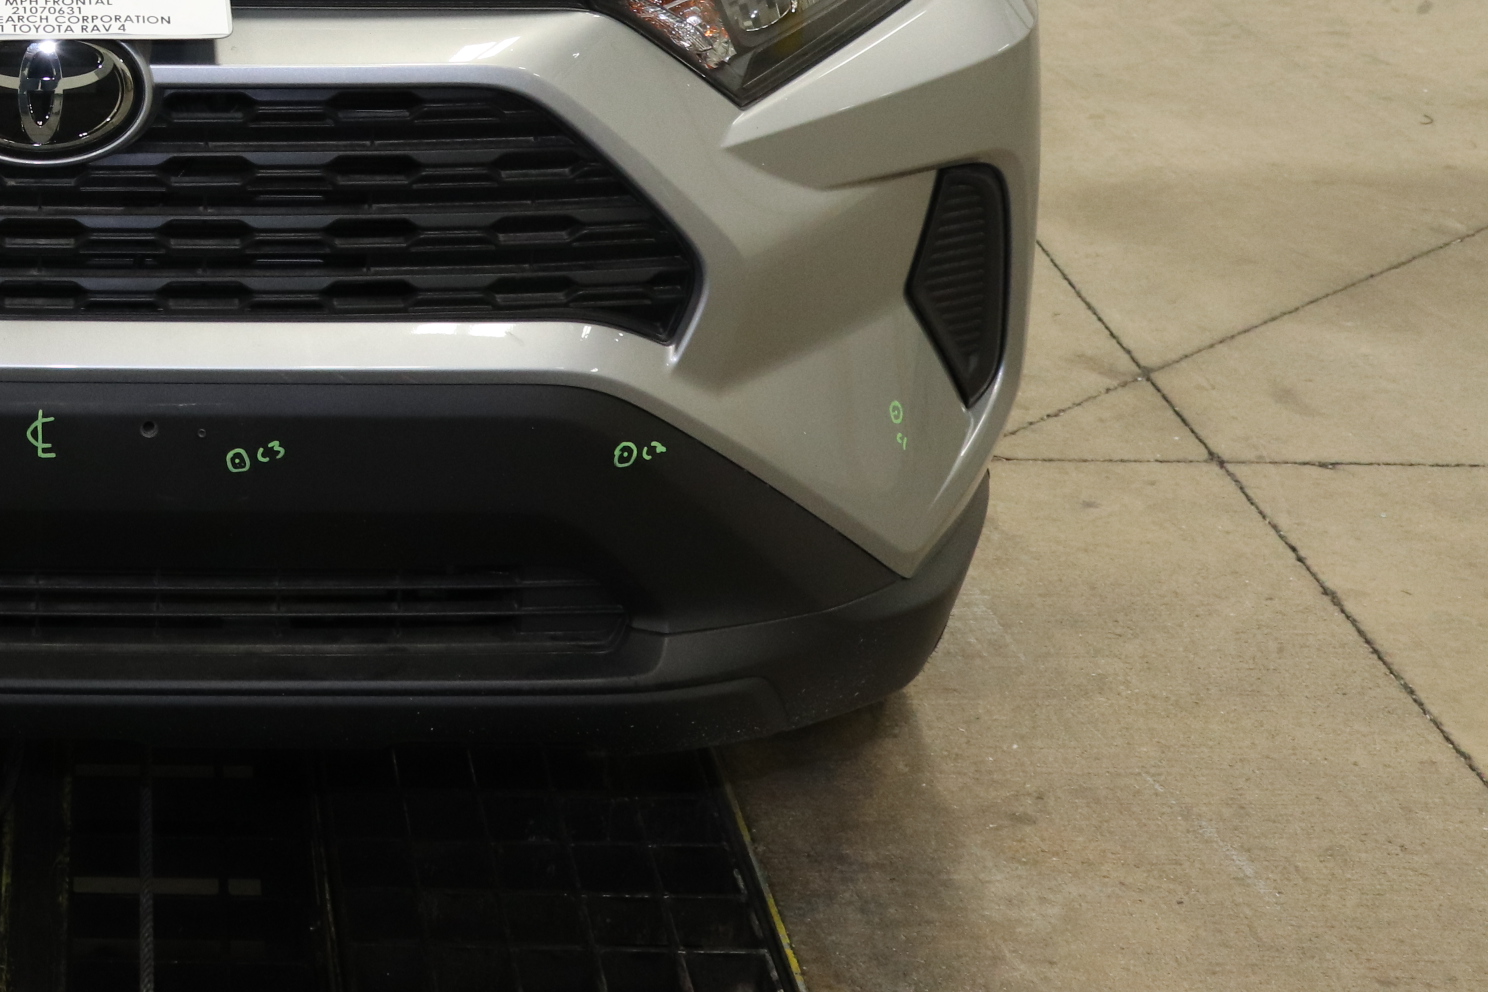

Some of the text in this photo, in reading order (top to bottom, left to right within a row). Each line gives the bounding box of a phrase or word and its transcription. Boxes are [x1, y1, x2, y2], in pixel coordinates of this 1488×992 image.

[12, 6, 83, 15] 21070631
[55, 14, 171, 25] CORPORATION
[12, 24, 74, 34] TOYOTA
[81, 24, 112, 33] RAV
[117, 23, 127, 33] 4
